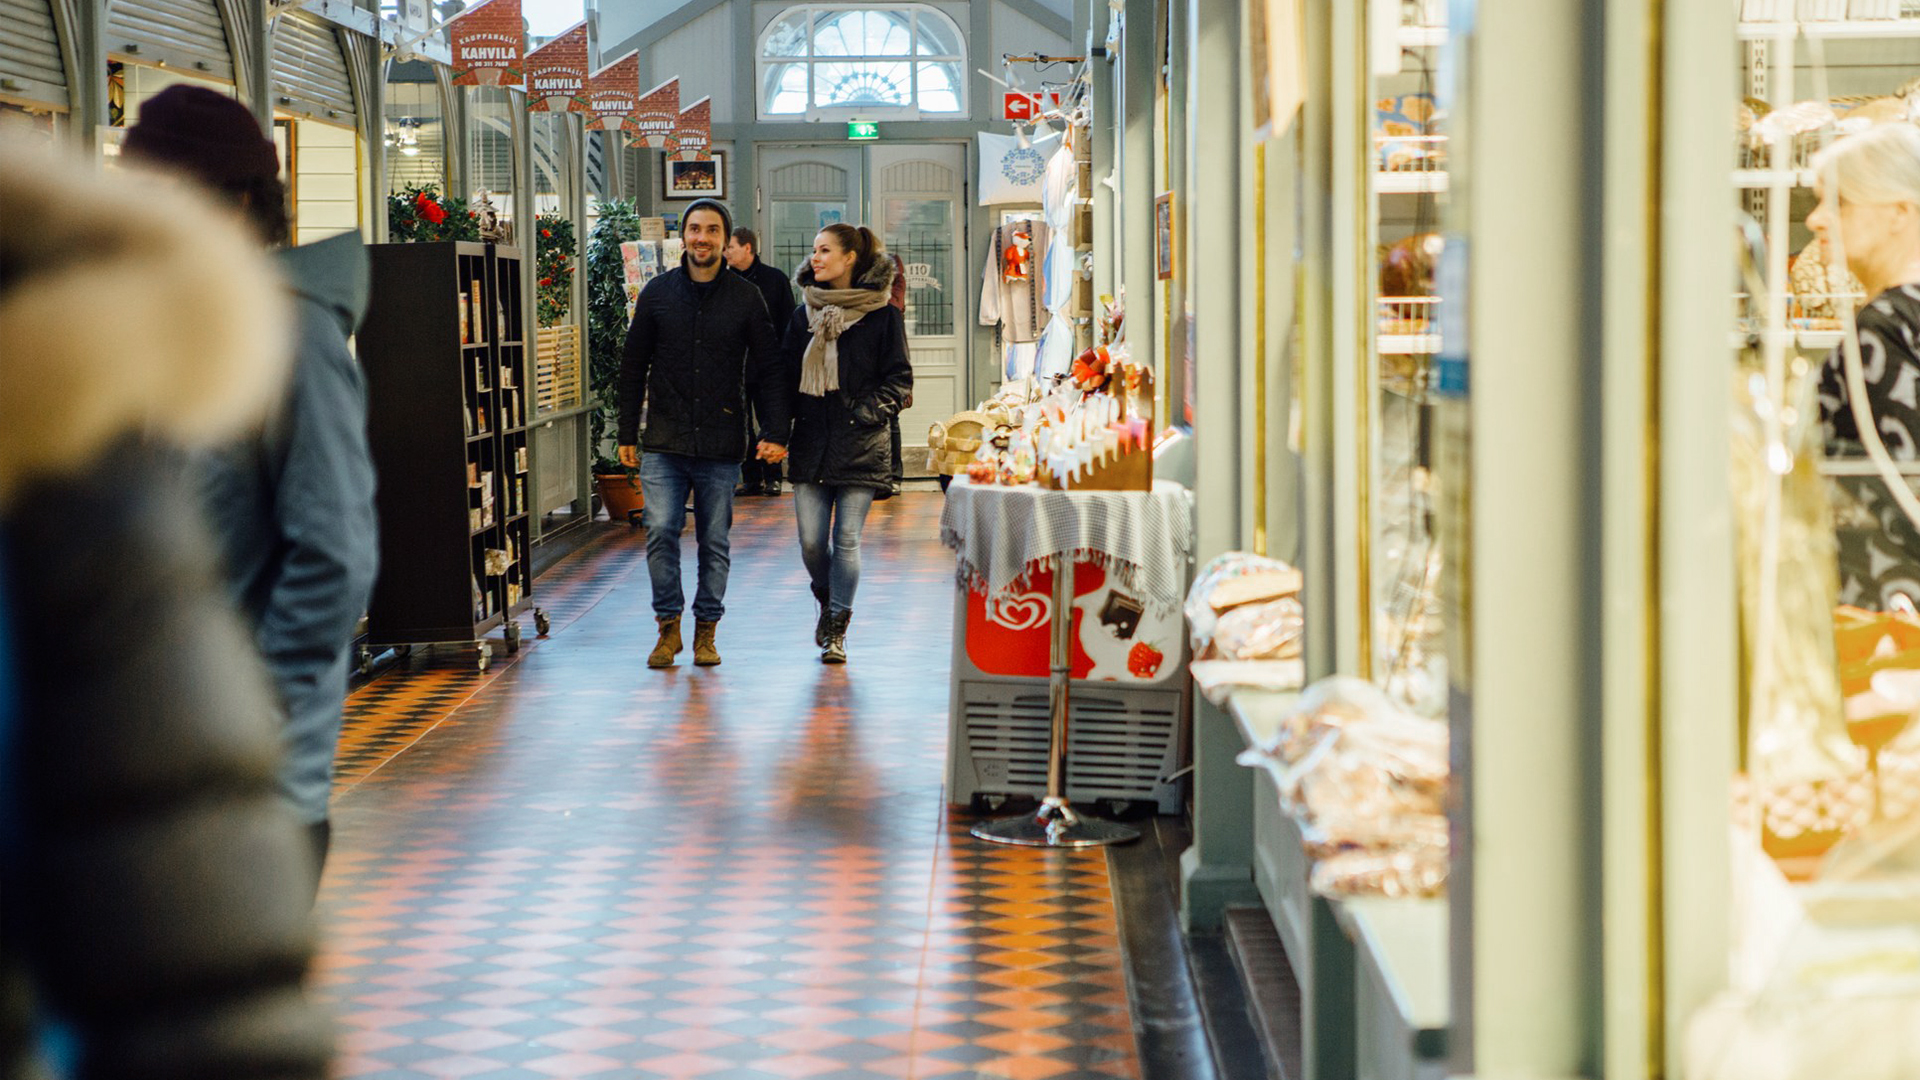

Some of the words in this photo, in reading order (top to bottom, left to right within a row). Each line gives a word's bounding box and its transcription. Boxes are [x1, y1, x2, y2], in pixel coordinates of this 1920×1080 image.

[459, 33, 517, 44] KAUPPAHALLI
[461, 46, 517, 59] KAHVILA
[533, 67, 582, 77] KAUPPAHALLI
[535, 79, 582, 89] KAHVILA
[592, 101, 634, 110] KAHVILA
[680, 137, 707, 145] AHVILA
[910, 265, 927, 275] 110
